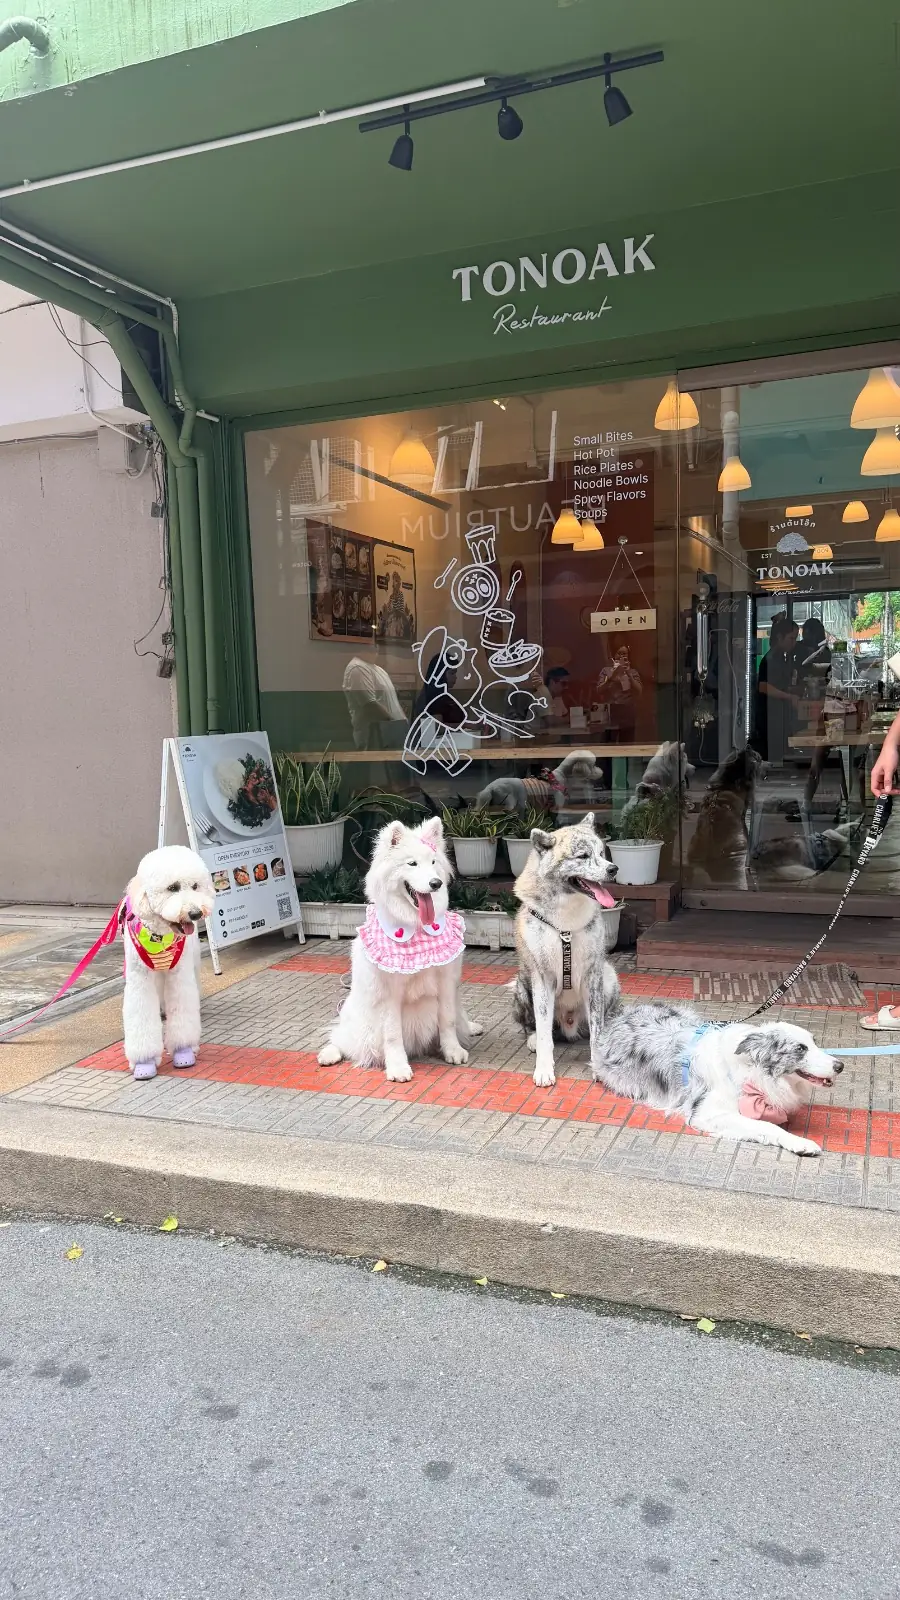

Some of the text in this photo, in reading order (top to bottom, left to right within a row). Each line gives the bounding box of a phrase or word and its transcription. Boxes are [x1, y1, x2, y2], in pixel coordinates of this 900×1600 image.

[452, 233, 656, 302] TONOAK
[492, 295, 612, 335] Restaurant
[573, 430, 633, 446] Small Bites
[573, 446, 615, 461] Hot Pot
[573, 460, 634, 475] Rice Plates
[573, 473, 648, 491] Noodle Bowls
[574, 488, 646, 508] Spicy Flavors
[574, 507, 608, 521] Soups
[756, 561, 834, 580] TONOAK
[600, 615, 647, 627] OPEN
[783, 960, 807, 988] BACKYARD
